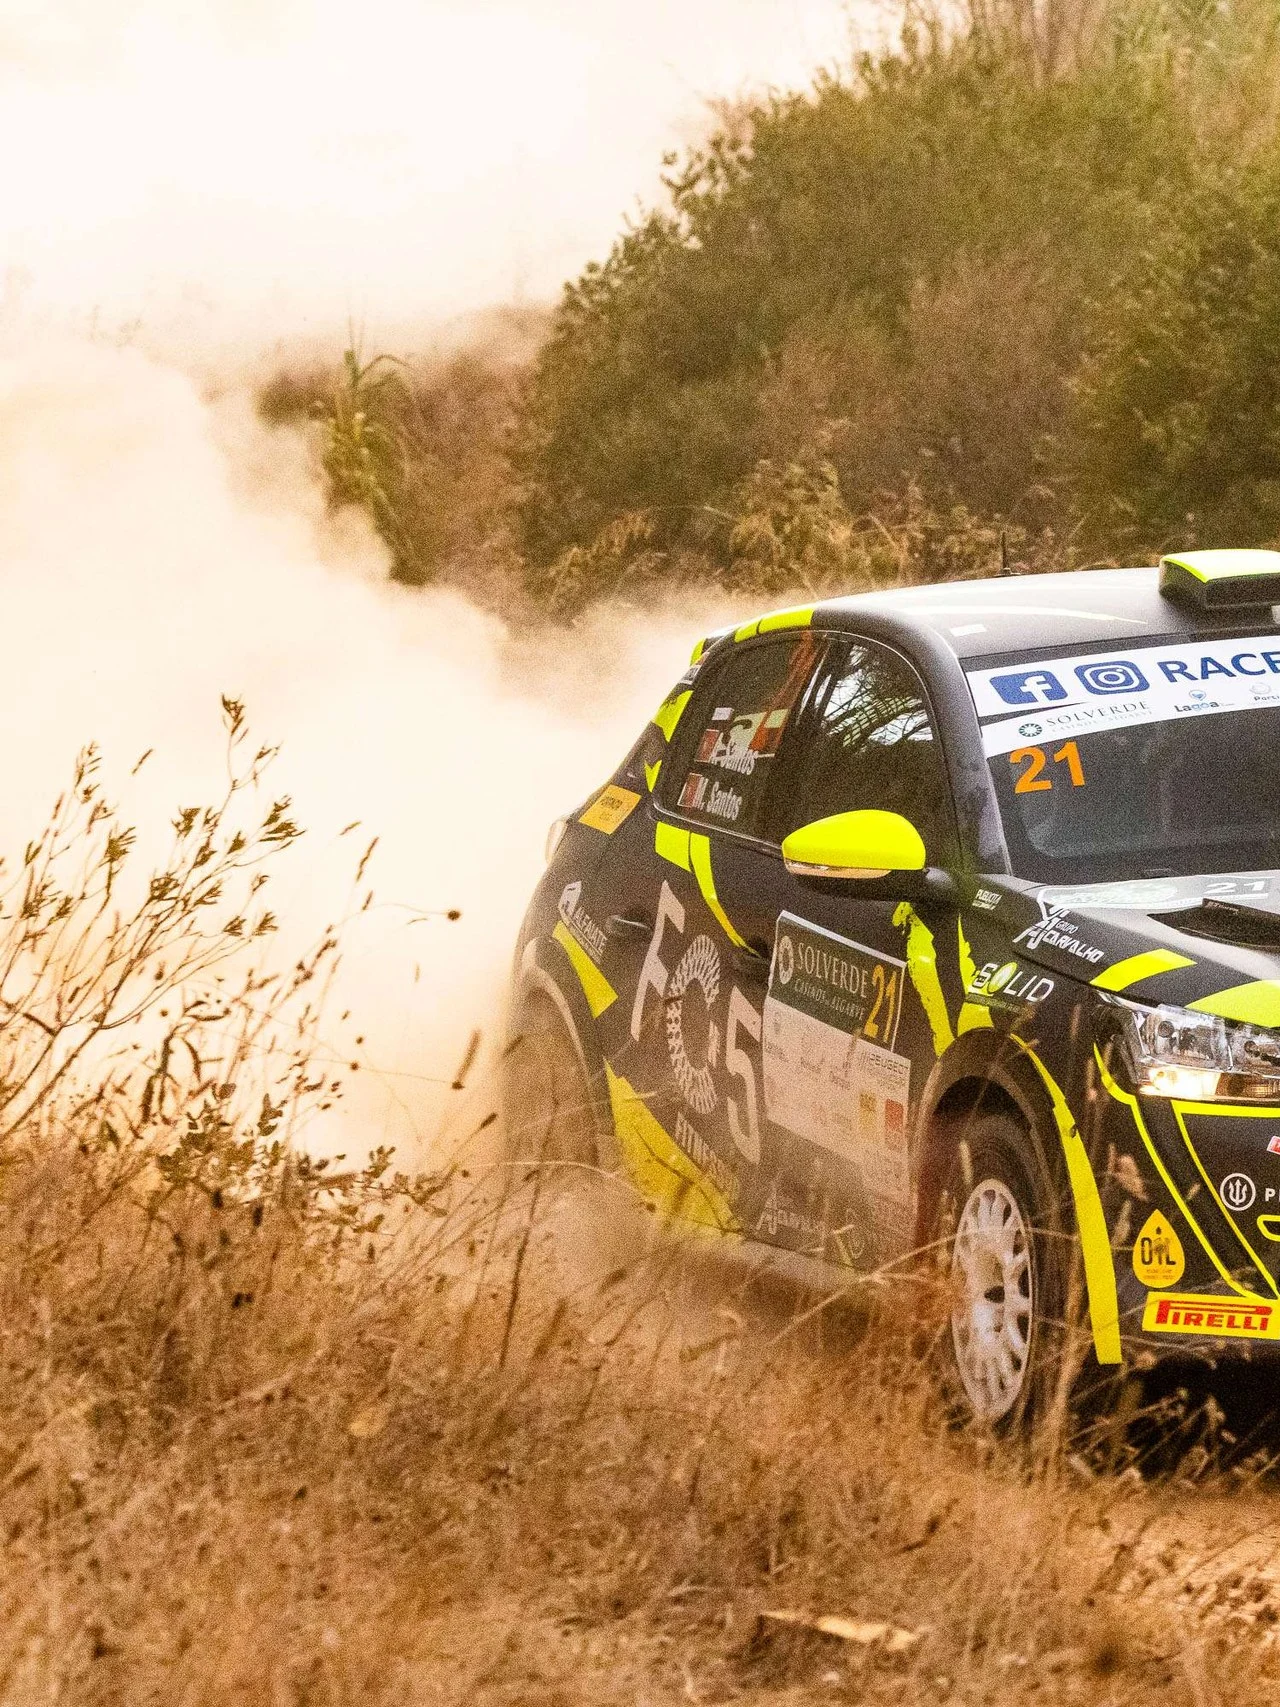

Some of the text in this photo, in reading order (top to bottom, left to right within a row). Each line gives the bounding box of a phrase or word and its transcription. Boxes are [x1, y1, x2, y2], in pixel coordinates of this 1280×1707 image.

[1046, 700, 1150, 727] SOLVERDE
[1174, 700, 1220, 713] Lagoa
[1009, 741, 1086, 794] 21
[1056, 920, 1079, 935] GRUPO
[1042, 930, 1105, 963] CARVALHO
[797, 942, 869, 998] SOLVERDE
[864, 964, 897, 1043] 21
[1155, 1300, 1273, 1331] PIRELLI
